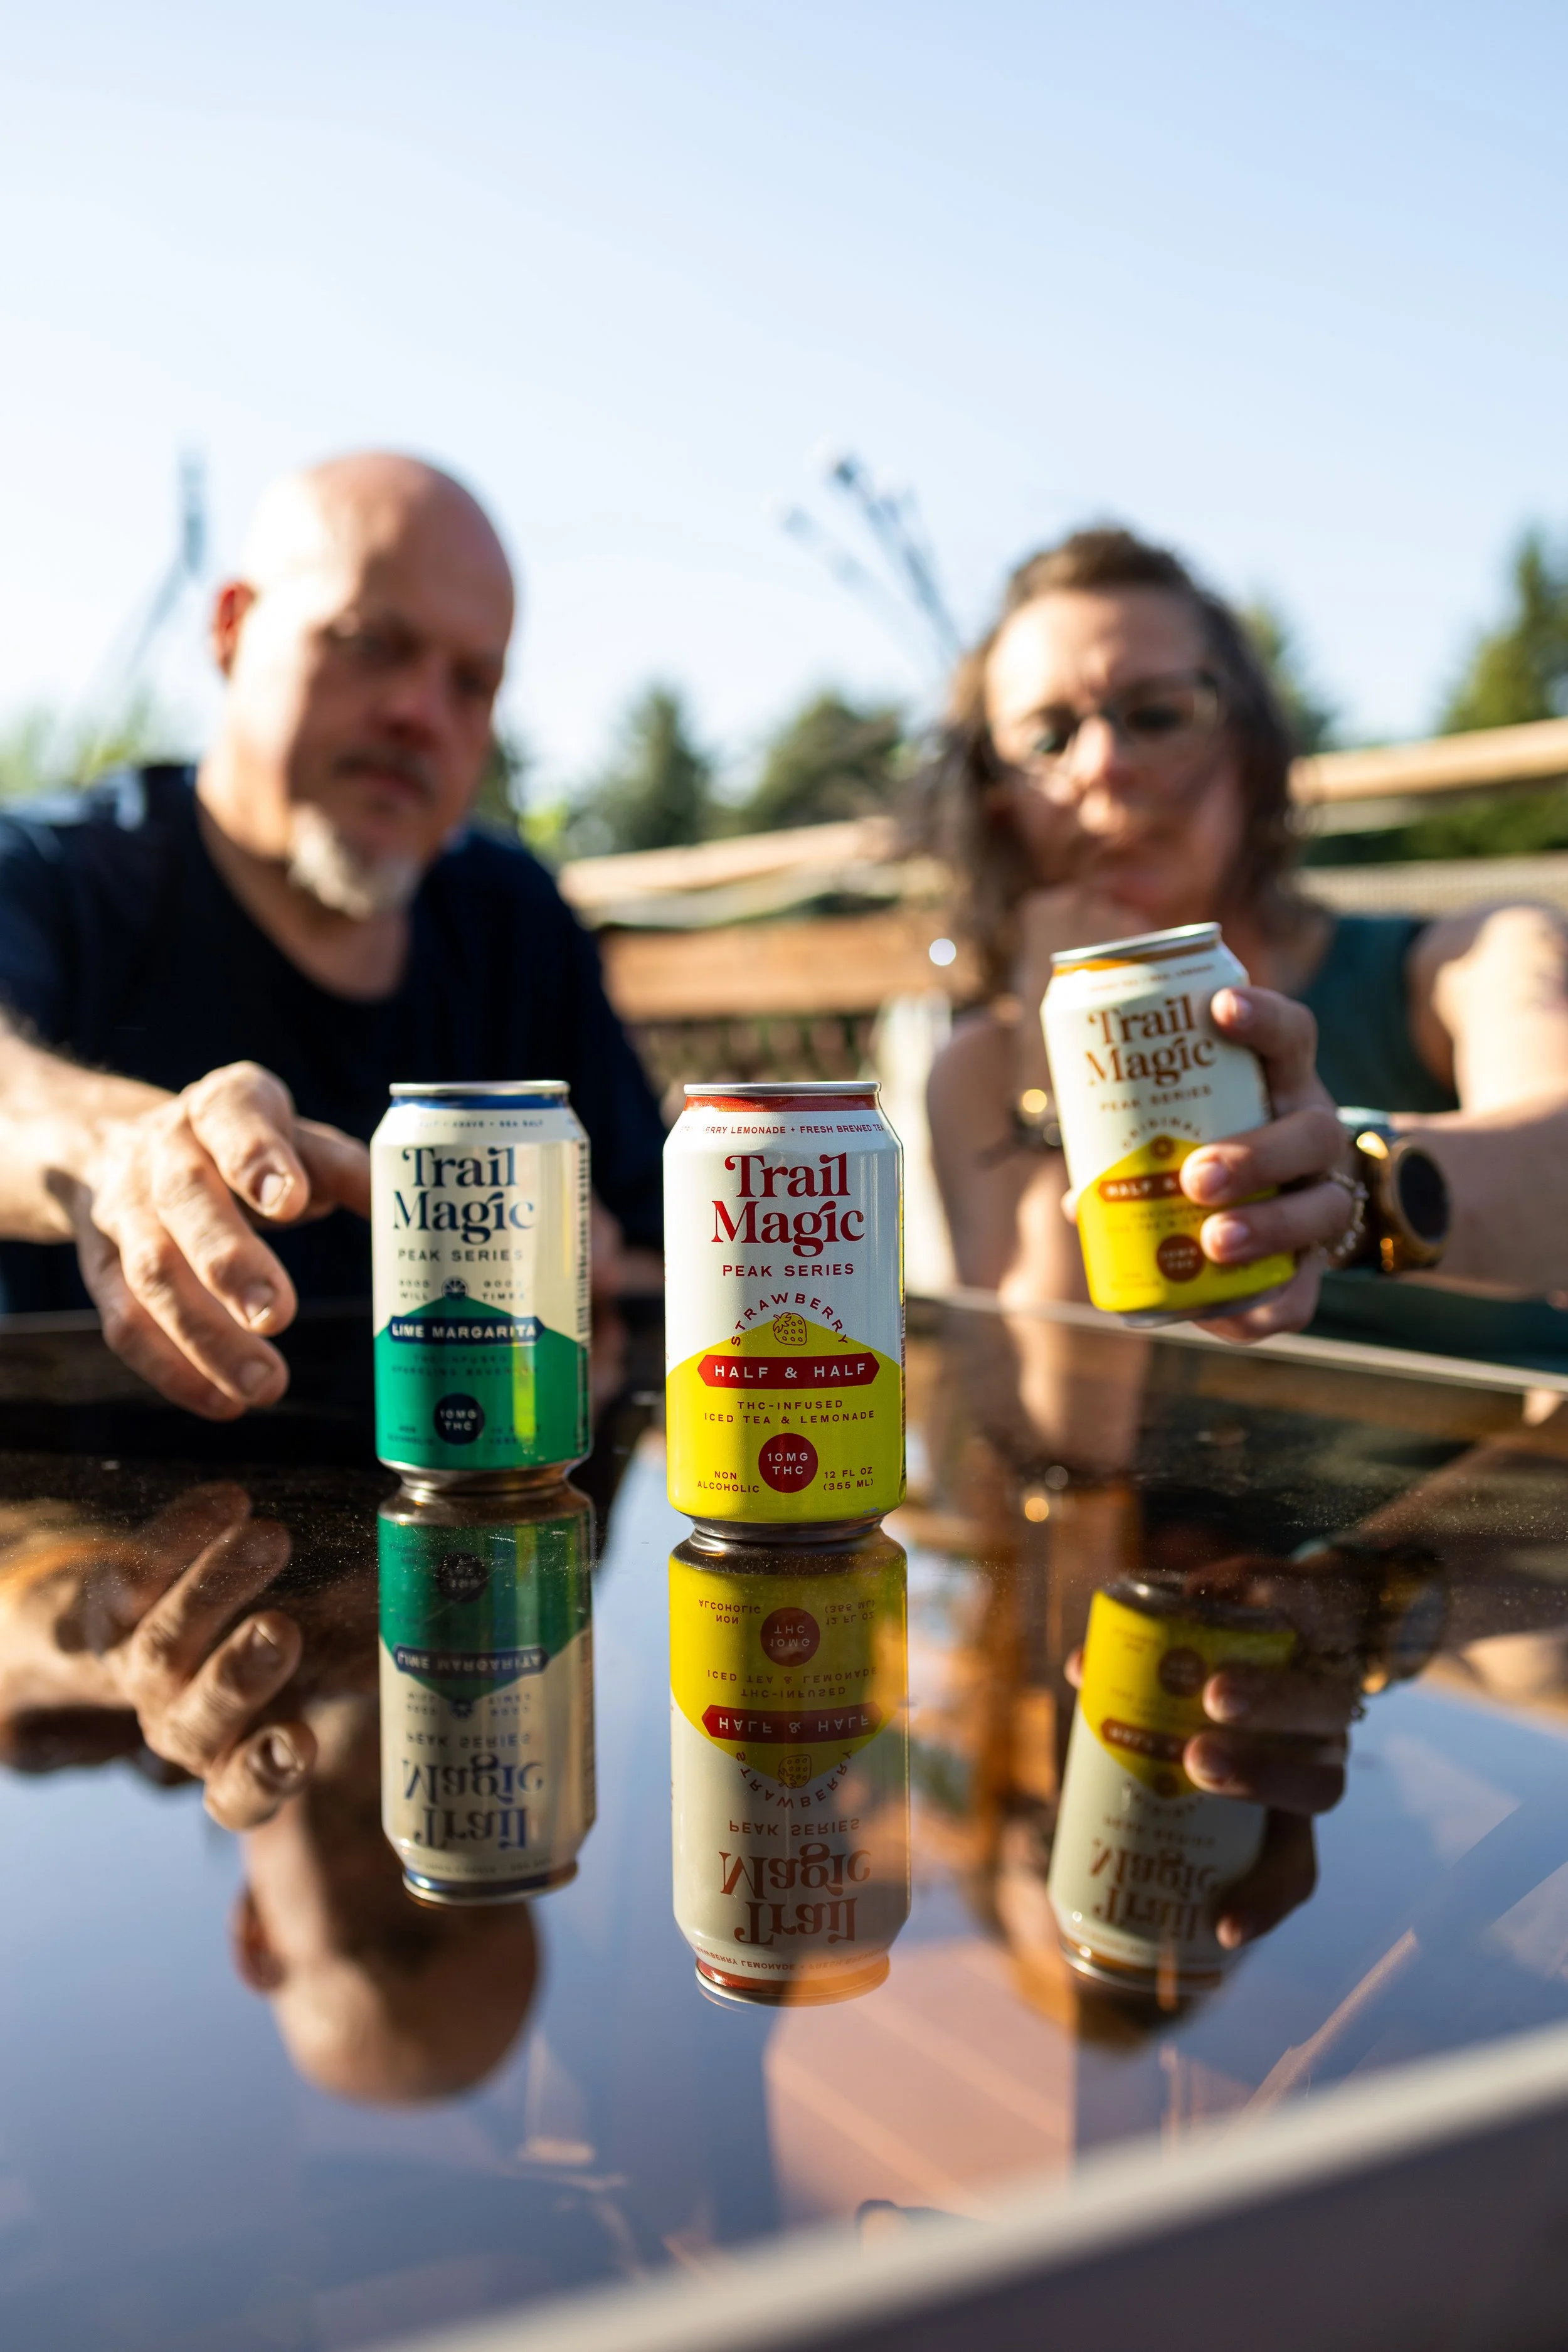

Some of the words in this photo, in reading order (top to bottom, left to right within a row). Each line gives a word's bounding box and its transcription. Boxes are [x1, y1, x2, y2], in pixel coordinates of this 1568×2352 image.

[1088, 992, 1197, 1046] Trail
[1085, 1036, 1217, 1088] Magic
[1150, 1083, 1213, 1106] SERIES
[731, 1125, 786, 1134] LEMONADE
[800, 1125, 834, 1133] FRESH
[836, 1123, 872, 1133] BREWED
[401, 1145, 519, 1188] Trail
[724, 1152, 851, 1197] Trail
[393, 1190, 534, 1245] Magic
[711, 1200, 866, 1258] Magic
[398, 1249, 442, 1261] PEAK
[451, 1249, 523, 1262] SERIES
[723, 1264, 773, 1277] PEAK
[784, 1263, 854, 1277] SERIES
[731, 1292, 848, 1347] STRAWBERRY
[391, 1323, 425, 1338] LIME
[432, 1324, 536, 1339] MARGARITA
[714, 1365, 768, 1379] HALF
[785, 1367, 798, 1379] &
[814, 1363, 866, 1378] HALF
[738, 1399, 843, 1411] THC-INFUSED
[440, 1409, 477, 1420] 10MG
[704, 1412, 734, 1422] ICED
[743, 1416, 771, 1424] TEA
[781, 1416, 790, 1424] &
[800, 1410, 875, 1424] LEMONADE
[444, 1421, 472, 1431] THC
[767, 1452, 809, 1463] 10MG
[714, 1471, 737, 1480] NON
[772, 1466, 803, 1475] THC
[824, 1471, 835, 1480] 12
[842, 1470, 855, 1478] FL
[861, 1466, 874, 1475] OZ
[697, 1480, 760, 1493] ALCOHOLIC
[823, 1481, 851, 1491] (355
[856, 1480, 874, 1489] ML)
